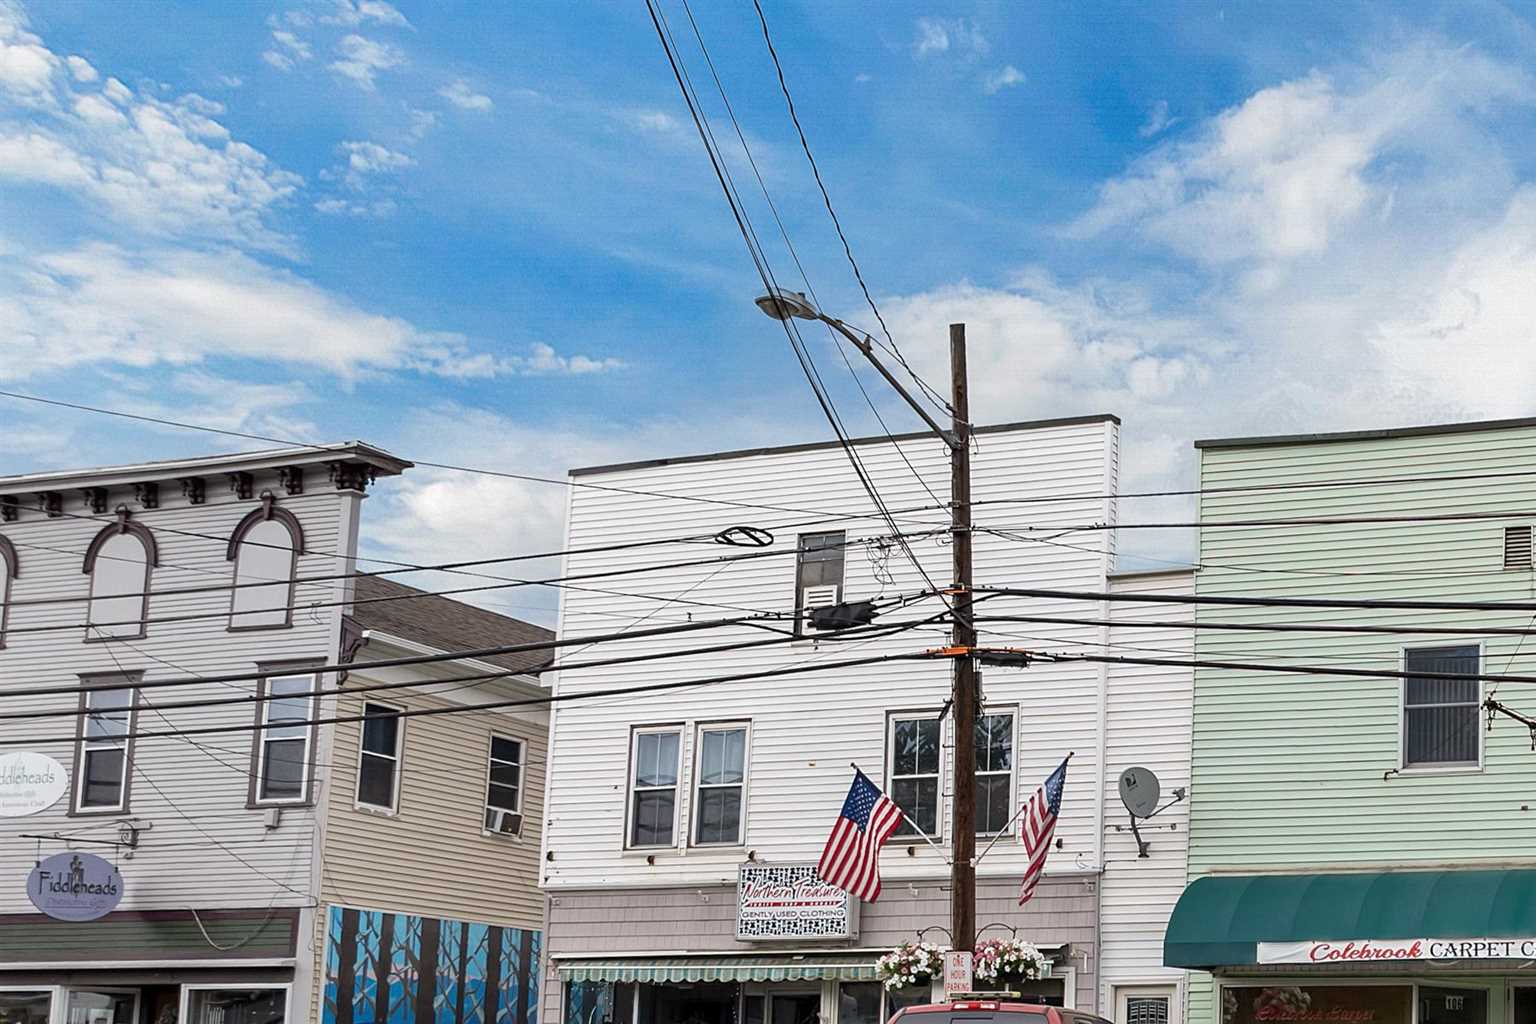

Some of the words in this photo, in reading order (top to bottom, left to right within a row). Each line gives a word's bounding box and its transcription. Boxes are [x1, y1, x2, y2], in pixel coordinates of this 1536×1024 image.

[39, 870, 117, 896] Fiddleheads
[742, 879, 793, 900] Northern
[742, 910, 775, 918] GENTLY
[776, 910, 798, 918] USED
[799, 909, 845, 918] CLOTHING
[1310, 940, 1423, 961] Colebrook
[1429, 941, 1515, 958] CARPET
[953, 957, 964, 967] ONE
[951, 970, 966, 979] HOUR
[945, 982, 970, 991] PARKING
